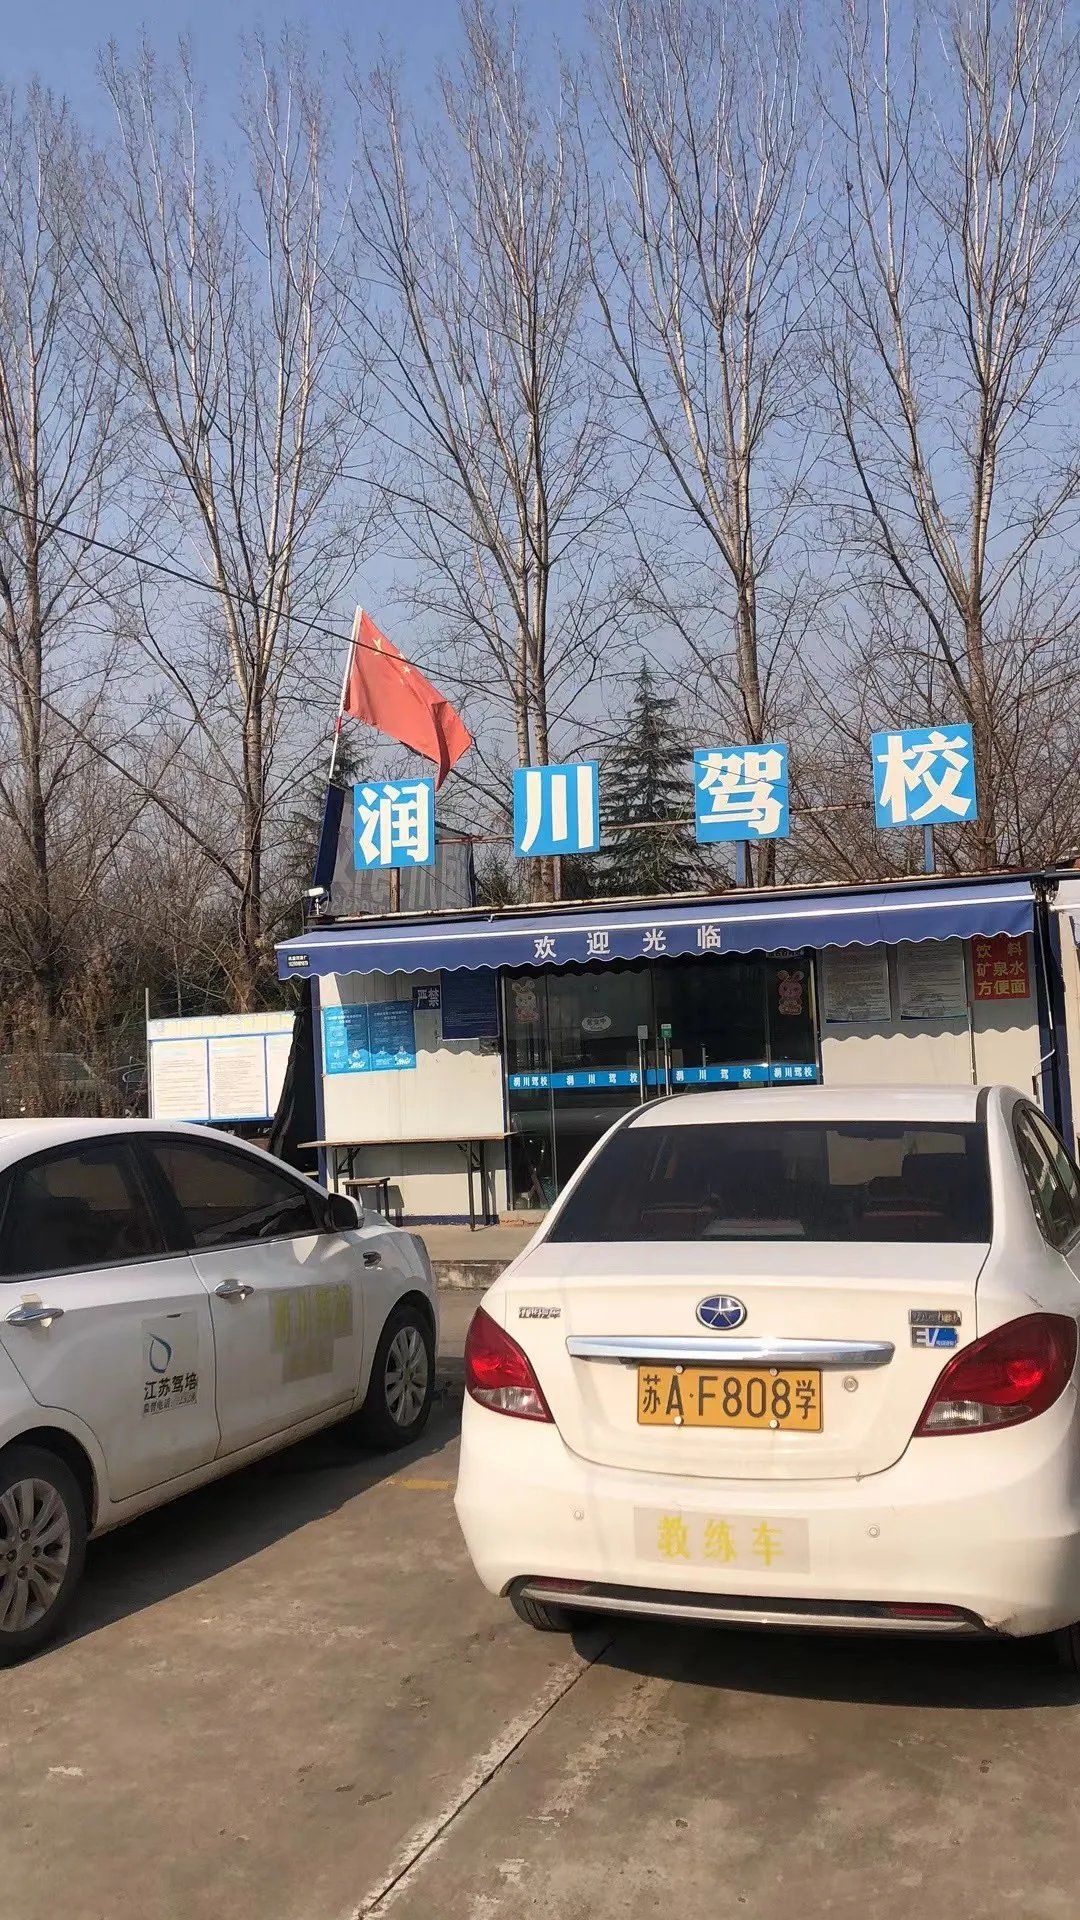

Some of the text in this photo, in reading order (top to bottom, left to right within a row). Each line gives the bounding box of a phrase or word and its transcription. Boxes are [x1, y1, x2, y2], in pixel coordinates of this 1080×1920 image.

[358, 730, 972, 865] 润川驾校
[533, 925, 721, 959] 欢迎光临
[975, 942, 1023, 959] 饮料
[976, 961, 1025, 977] 矿泉水
[416, 987, 440, 1008] 严禁
[978, 979, 1026, 995] 方便面
[916, 1328, 940, 1347] EV
[144, 1372, 198, 1401] 江苏驾培
[656, 1515, 784, 1567] 教练车
